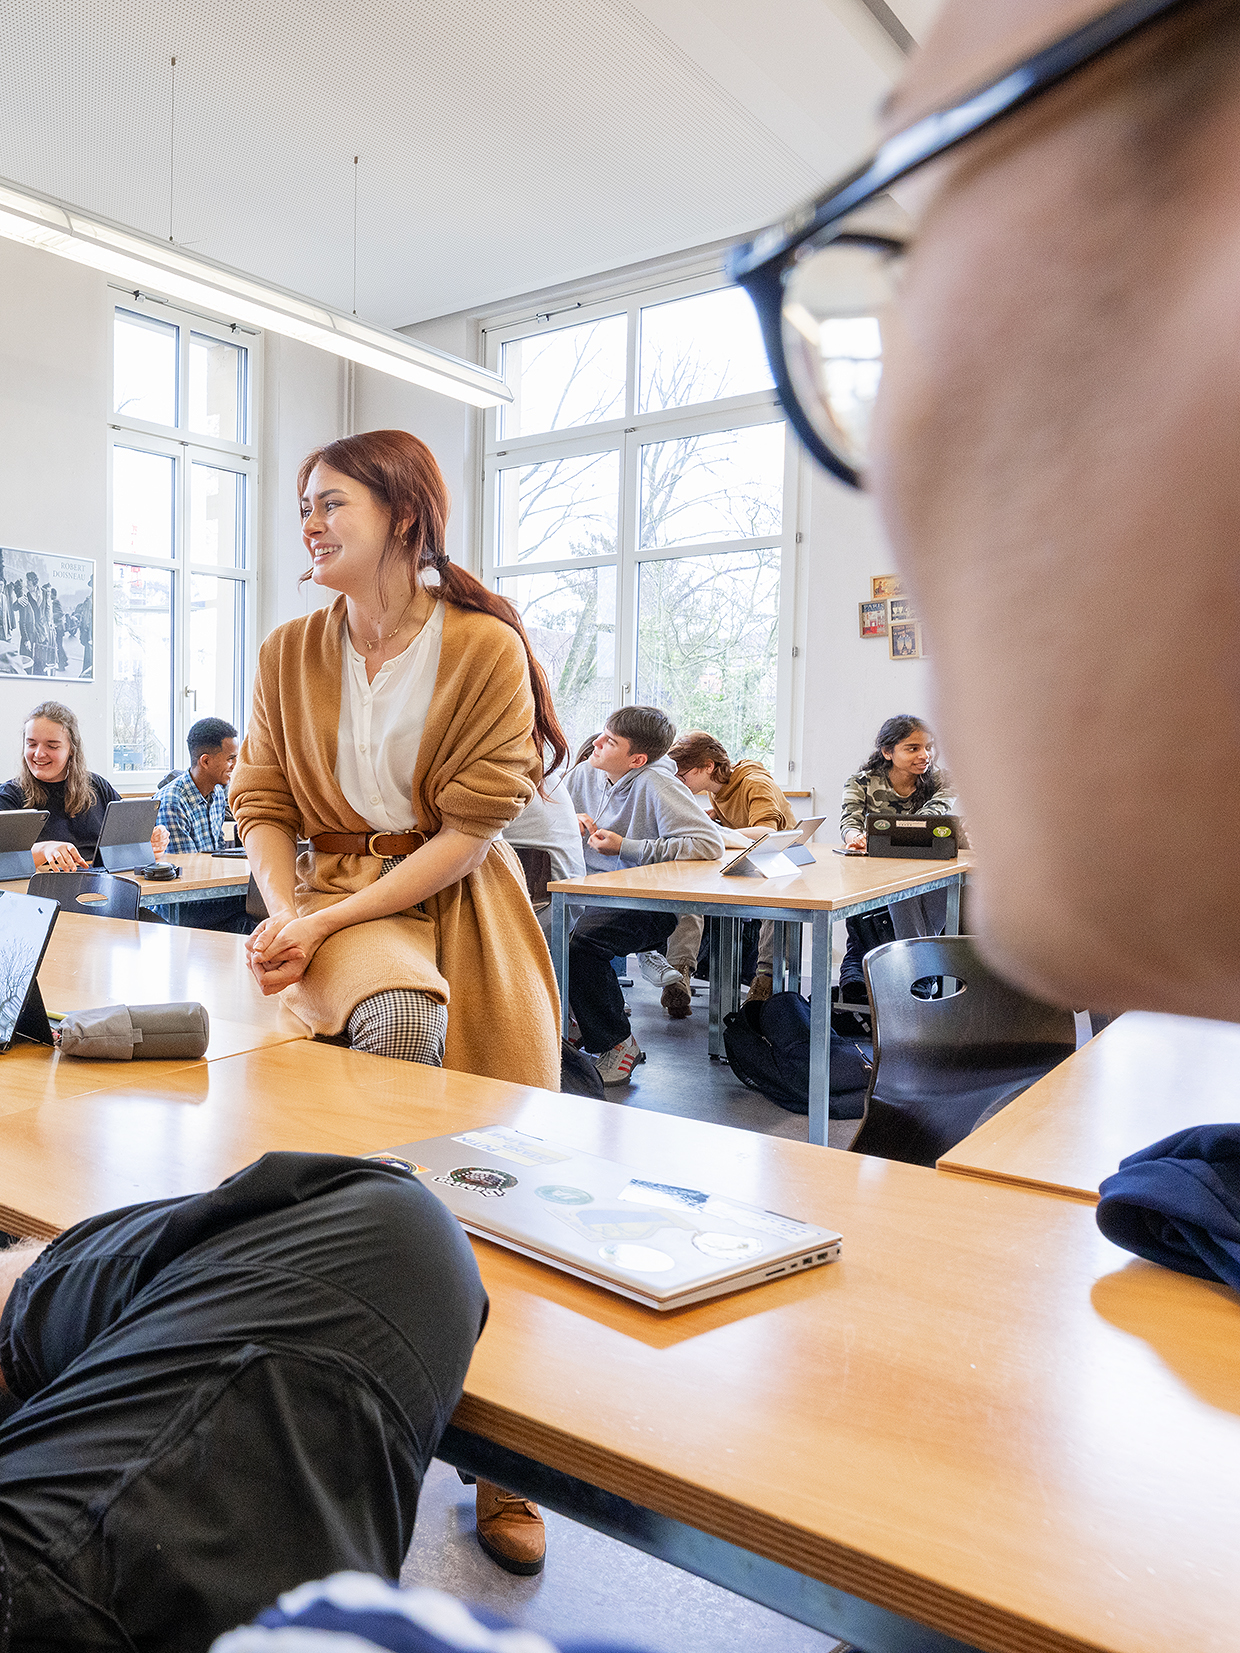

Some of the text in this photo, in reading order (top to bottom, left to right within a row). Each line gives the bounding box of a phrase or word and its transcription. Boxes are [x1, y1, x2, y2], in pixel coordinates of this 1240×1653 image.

[61, 562, 86, 571] ROBERT
[53, 570, 86, 581] DOISNEAU
[457, 1136, 500, 1152] PUTIN
[502, 1144, 545, 1160] STAND
